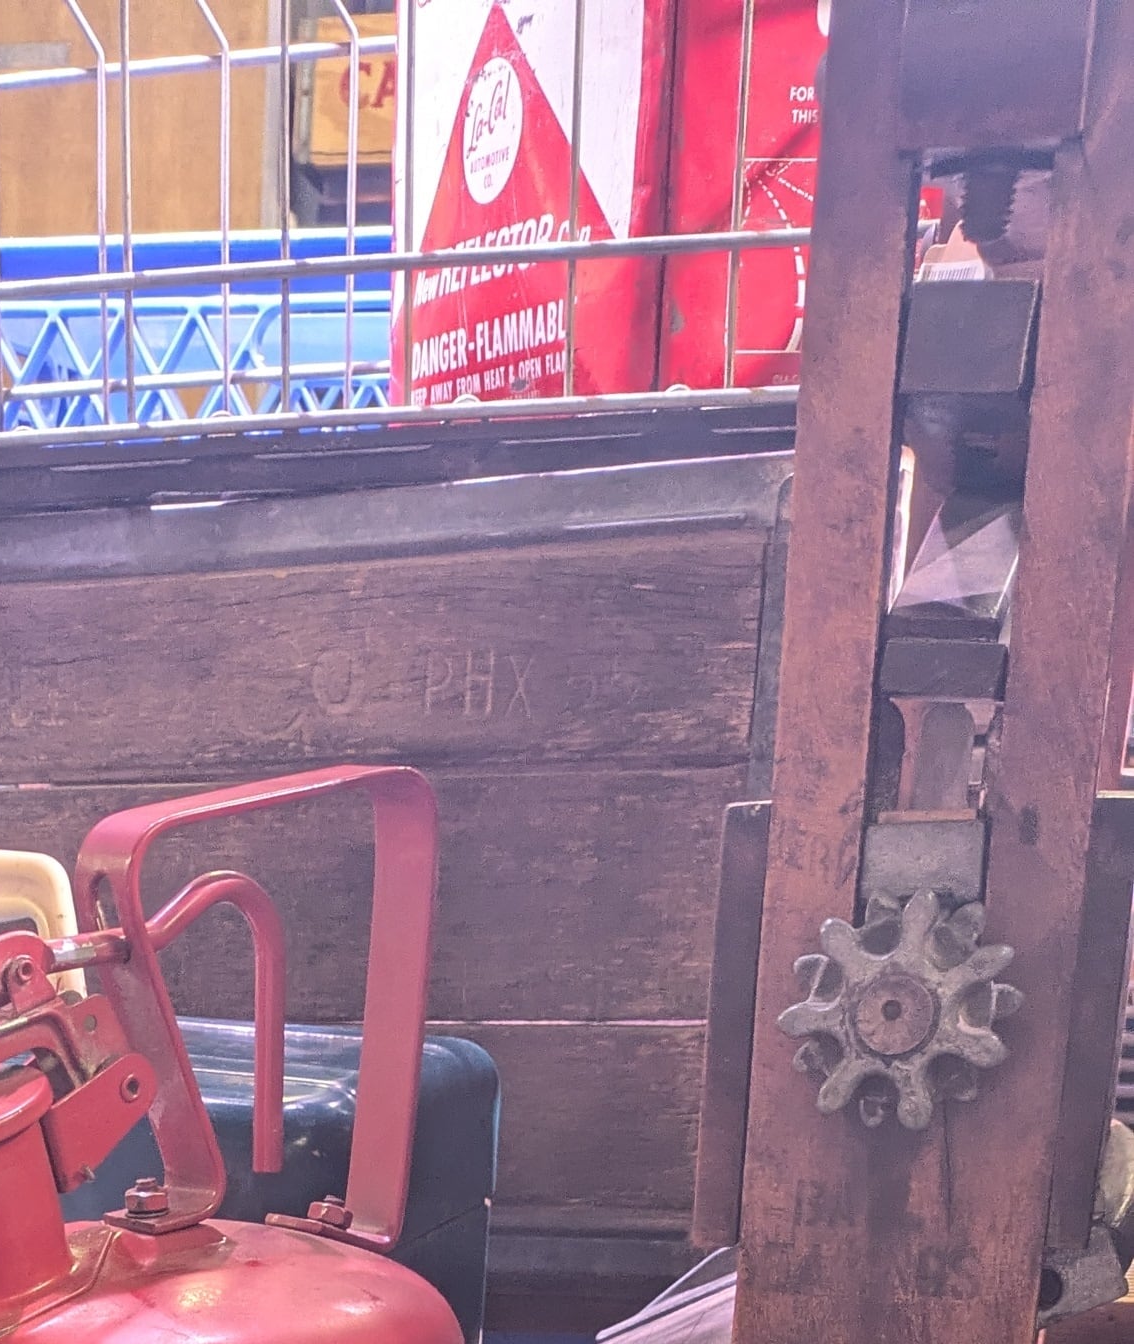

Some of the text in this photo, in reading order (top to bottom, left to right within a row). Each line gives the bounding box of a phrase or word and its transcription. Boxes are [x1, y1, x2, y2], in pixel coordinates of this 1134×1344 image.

[789, 86, 815, 101] FOR
[792, 108, 818, 123] THIS
[470, 146, 510, 174] AUTOMOTIVE
[412, 299, 572, 380] DANGER-FLAMMABL
[430, 381, 454, 404] AWAY
[456, 373, 482, 398] FROM
[483, 366, 505, 391] HEAT
